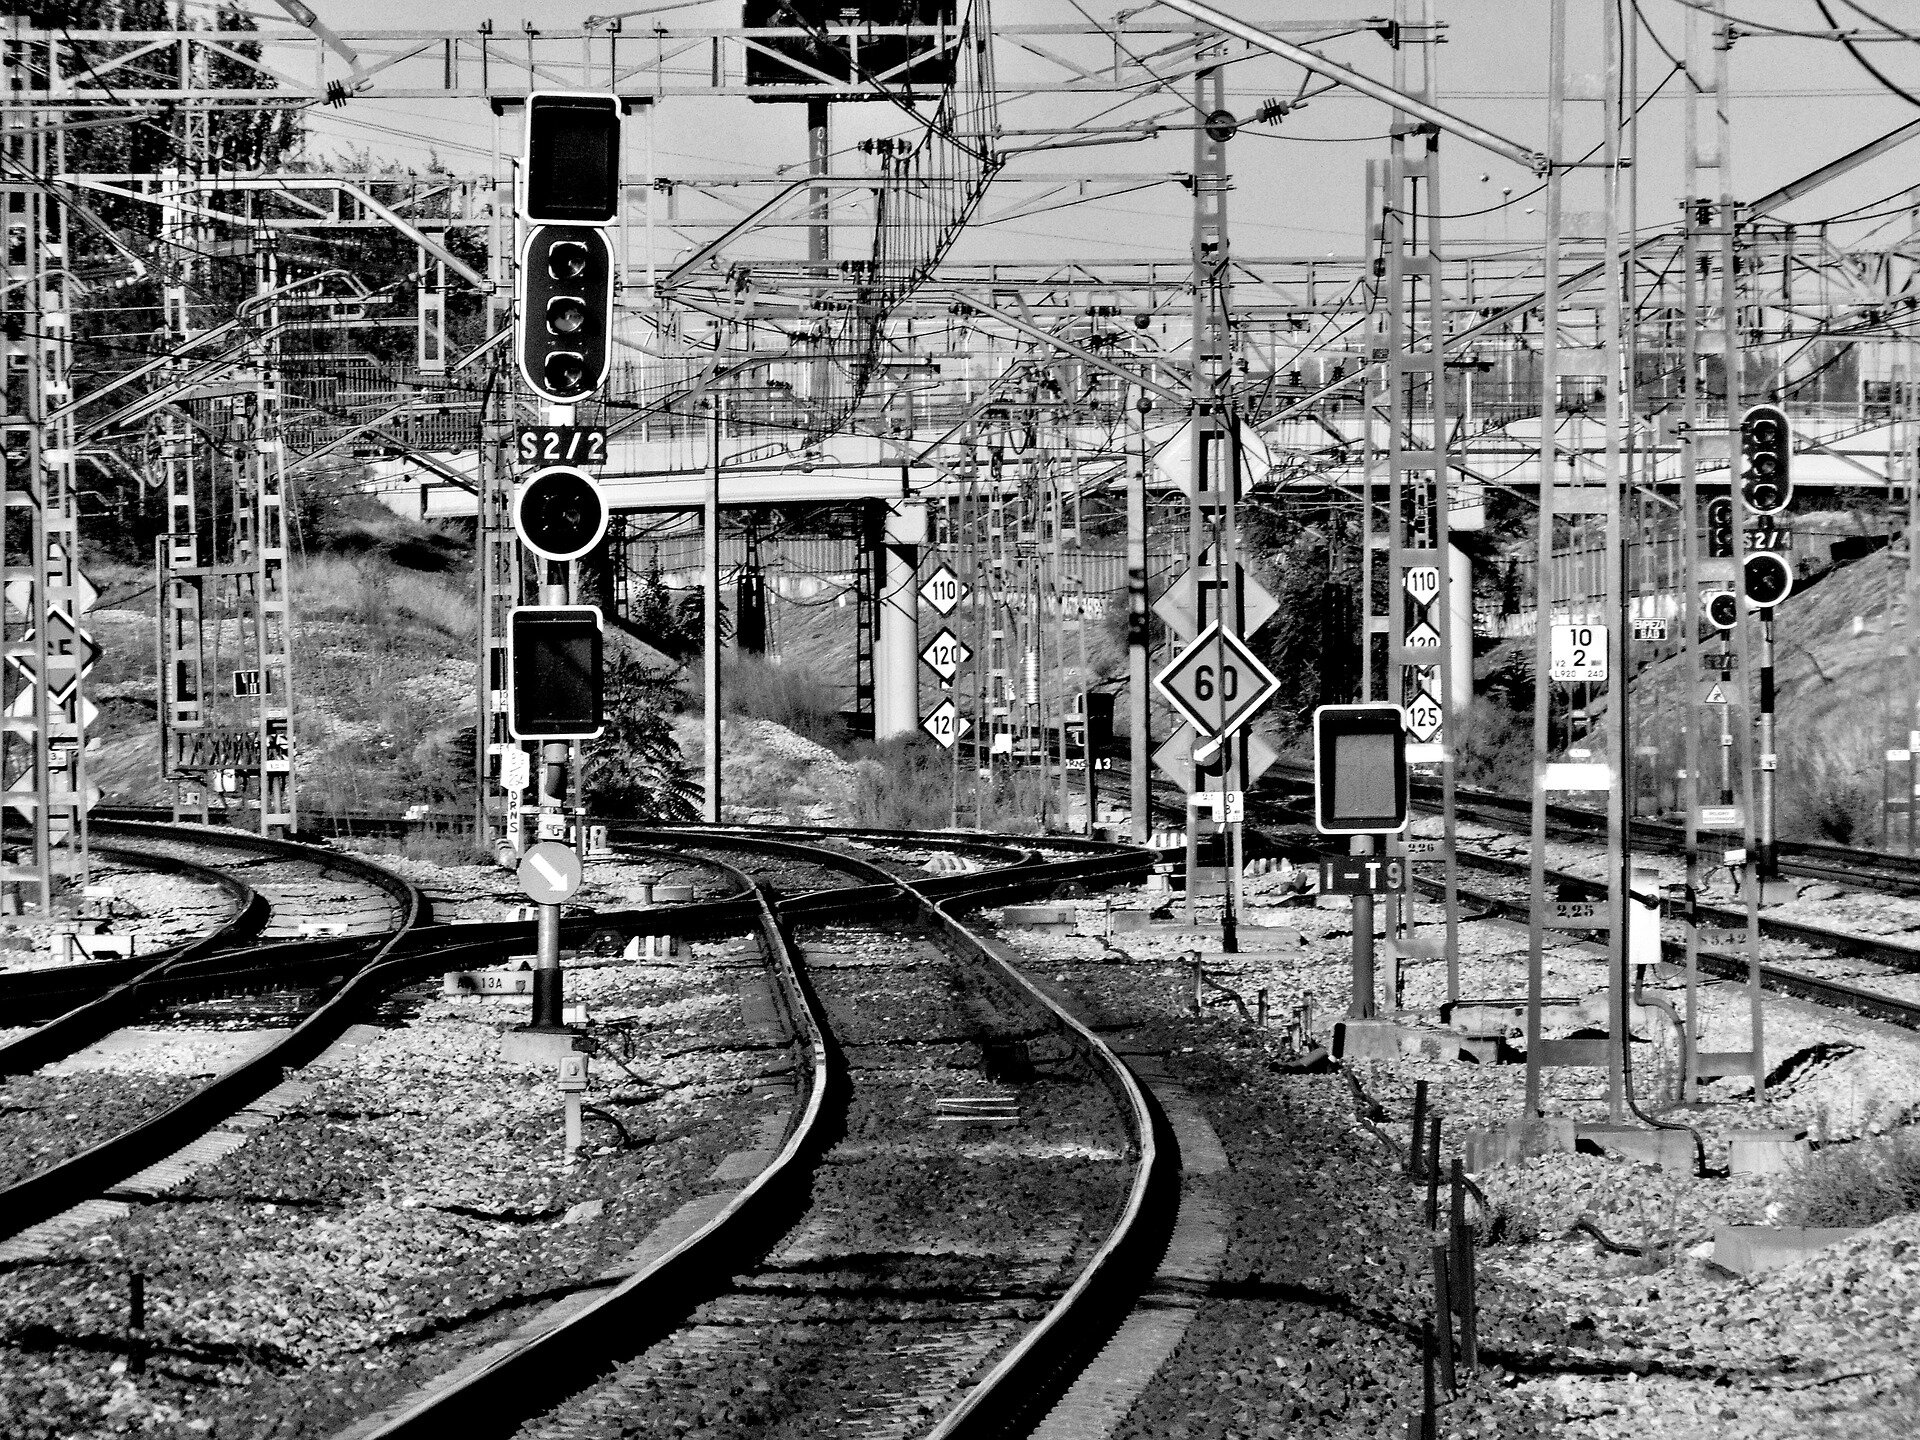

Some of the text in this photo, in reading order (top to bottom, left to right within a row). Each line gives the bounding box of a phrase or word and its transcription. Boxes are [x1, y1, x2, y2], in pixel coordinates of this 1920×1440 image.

[521, 432, 604, 459] S2/2
[932, 581, 956, 600] 110
[1412, 572, 1436, 591] 110
[1570, 628, 1592, 647] 10
[1573, 650, 1586, 667] 2
[1195, 665, 1238, 701] 60
[1411, 708, 1437, 726] 125
[510, 791, 519, 833] DRNS
[482, 977, 502, 989] 13A
